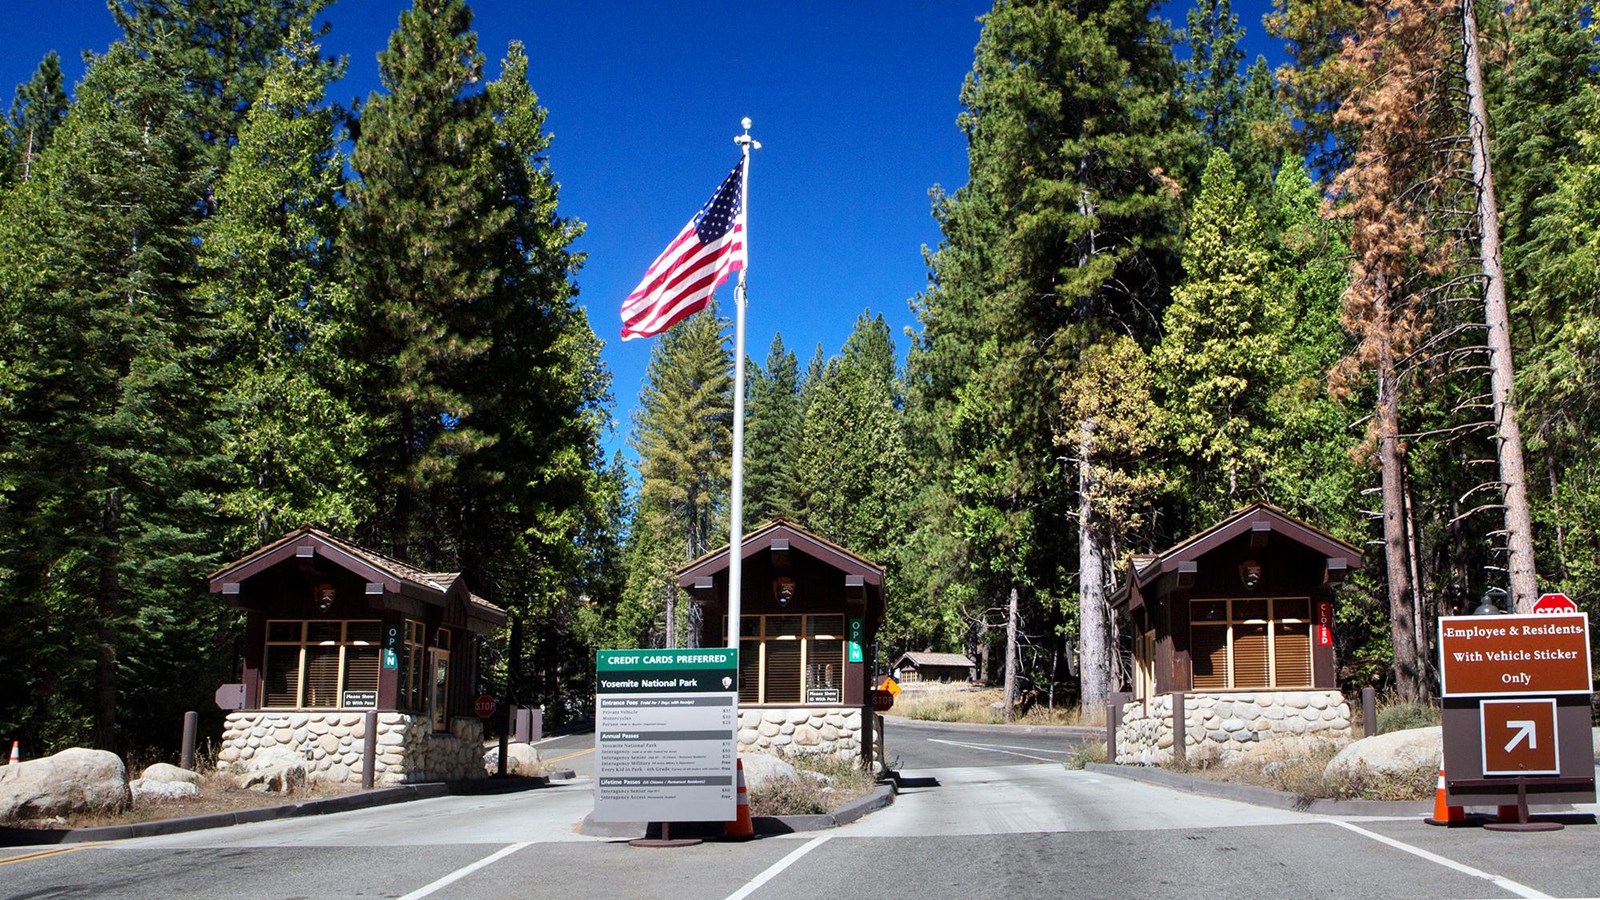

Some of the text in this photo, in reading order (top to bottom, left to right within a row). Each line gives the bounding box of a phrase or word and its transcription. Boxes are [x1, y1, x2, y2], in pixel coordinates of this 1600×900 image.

[1446, 624, 1581, 639] Employee & Residents
[386, 628, 396, 666] OPEN
[852, 621, 860, 660] OPEN
[608, 654, 727, 664] CREDIT CARDS PREFERRED
[1453, 649, 1578, 662] With Vehicle Sticker
[600, 678, 698, 688] Yosemite National Park
[1502, 672, 1531, 685] Only
[475, 702, 496, 710] STOP
[872, 696, 892, 704] STOP
